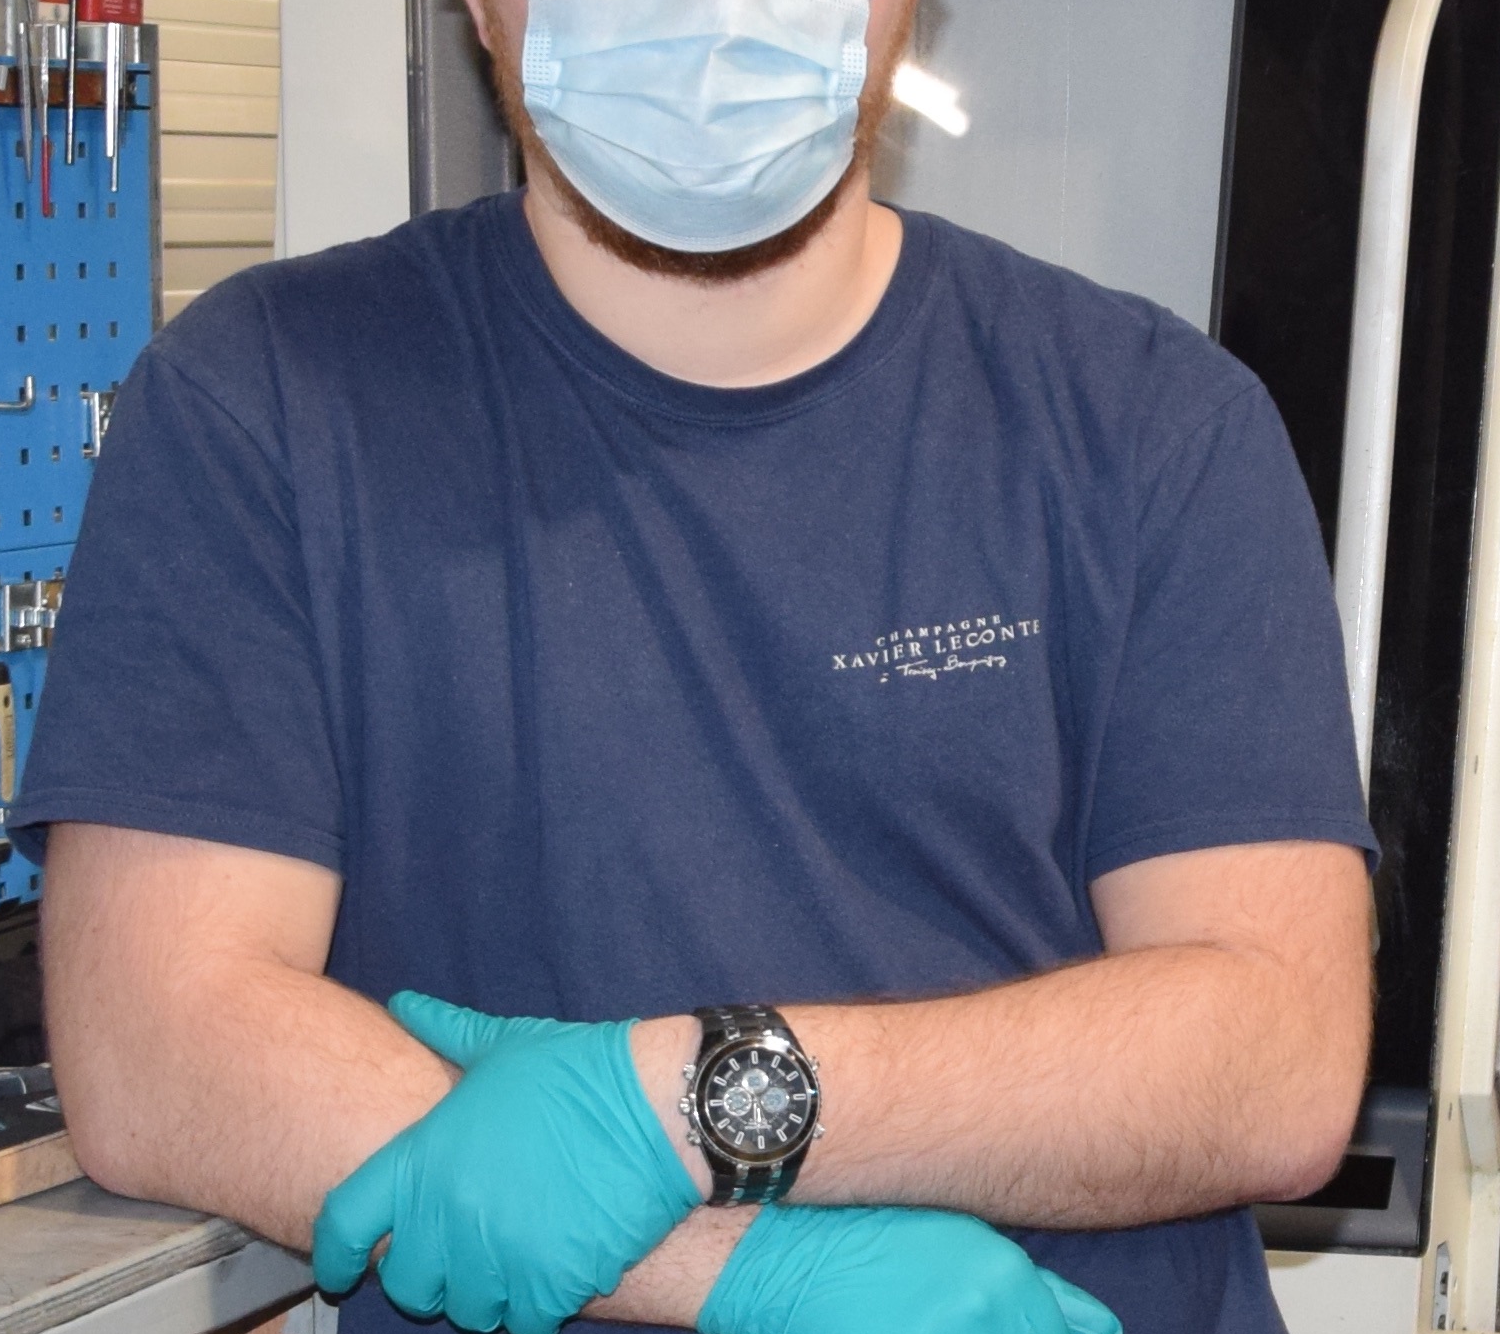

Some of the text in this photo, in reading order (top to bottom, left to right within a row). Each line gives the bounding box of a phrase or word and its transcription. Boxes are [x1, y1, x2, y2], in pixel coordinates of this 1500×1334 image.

[833, 619, 1040, 670] XAVIER LECONTE
[876, 615, 1000, 646] CHAMPAGNE
